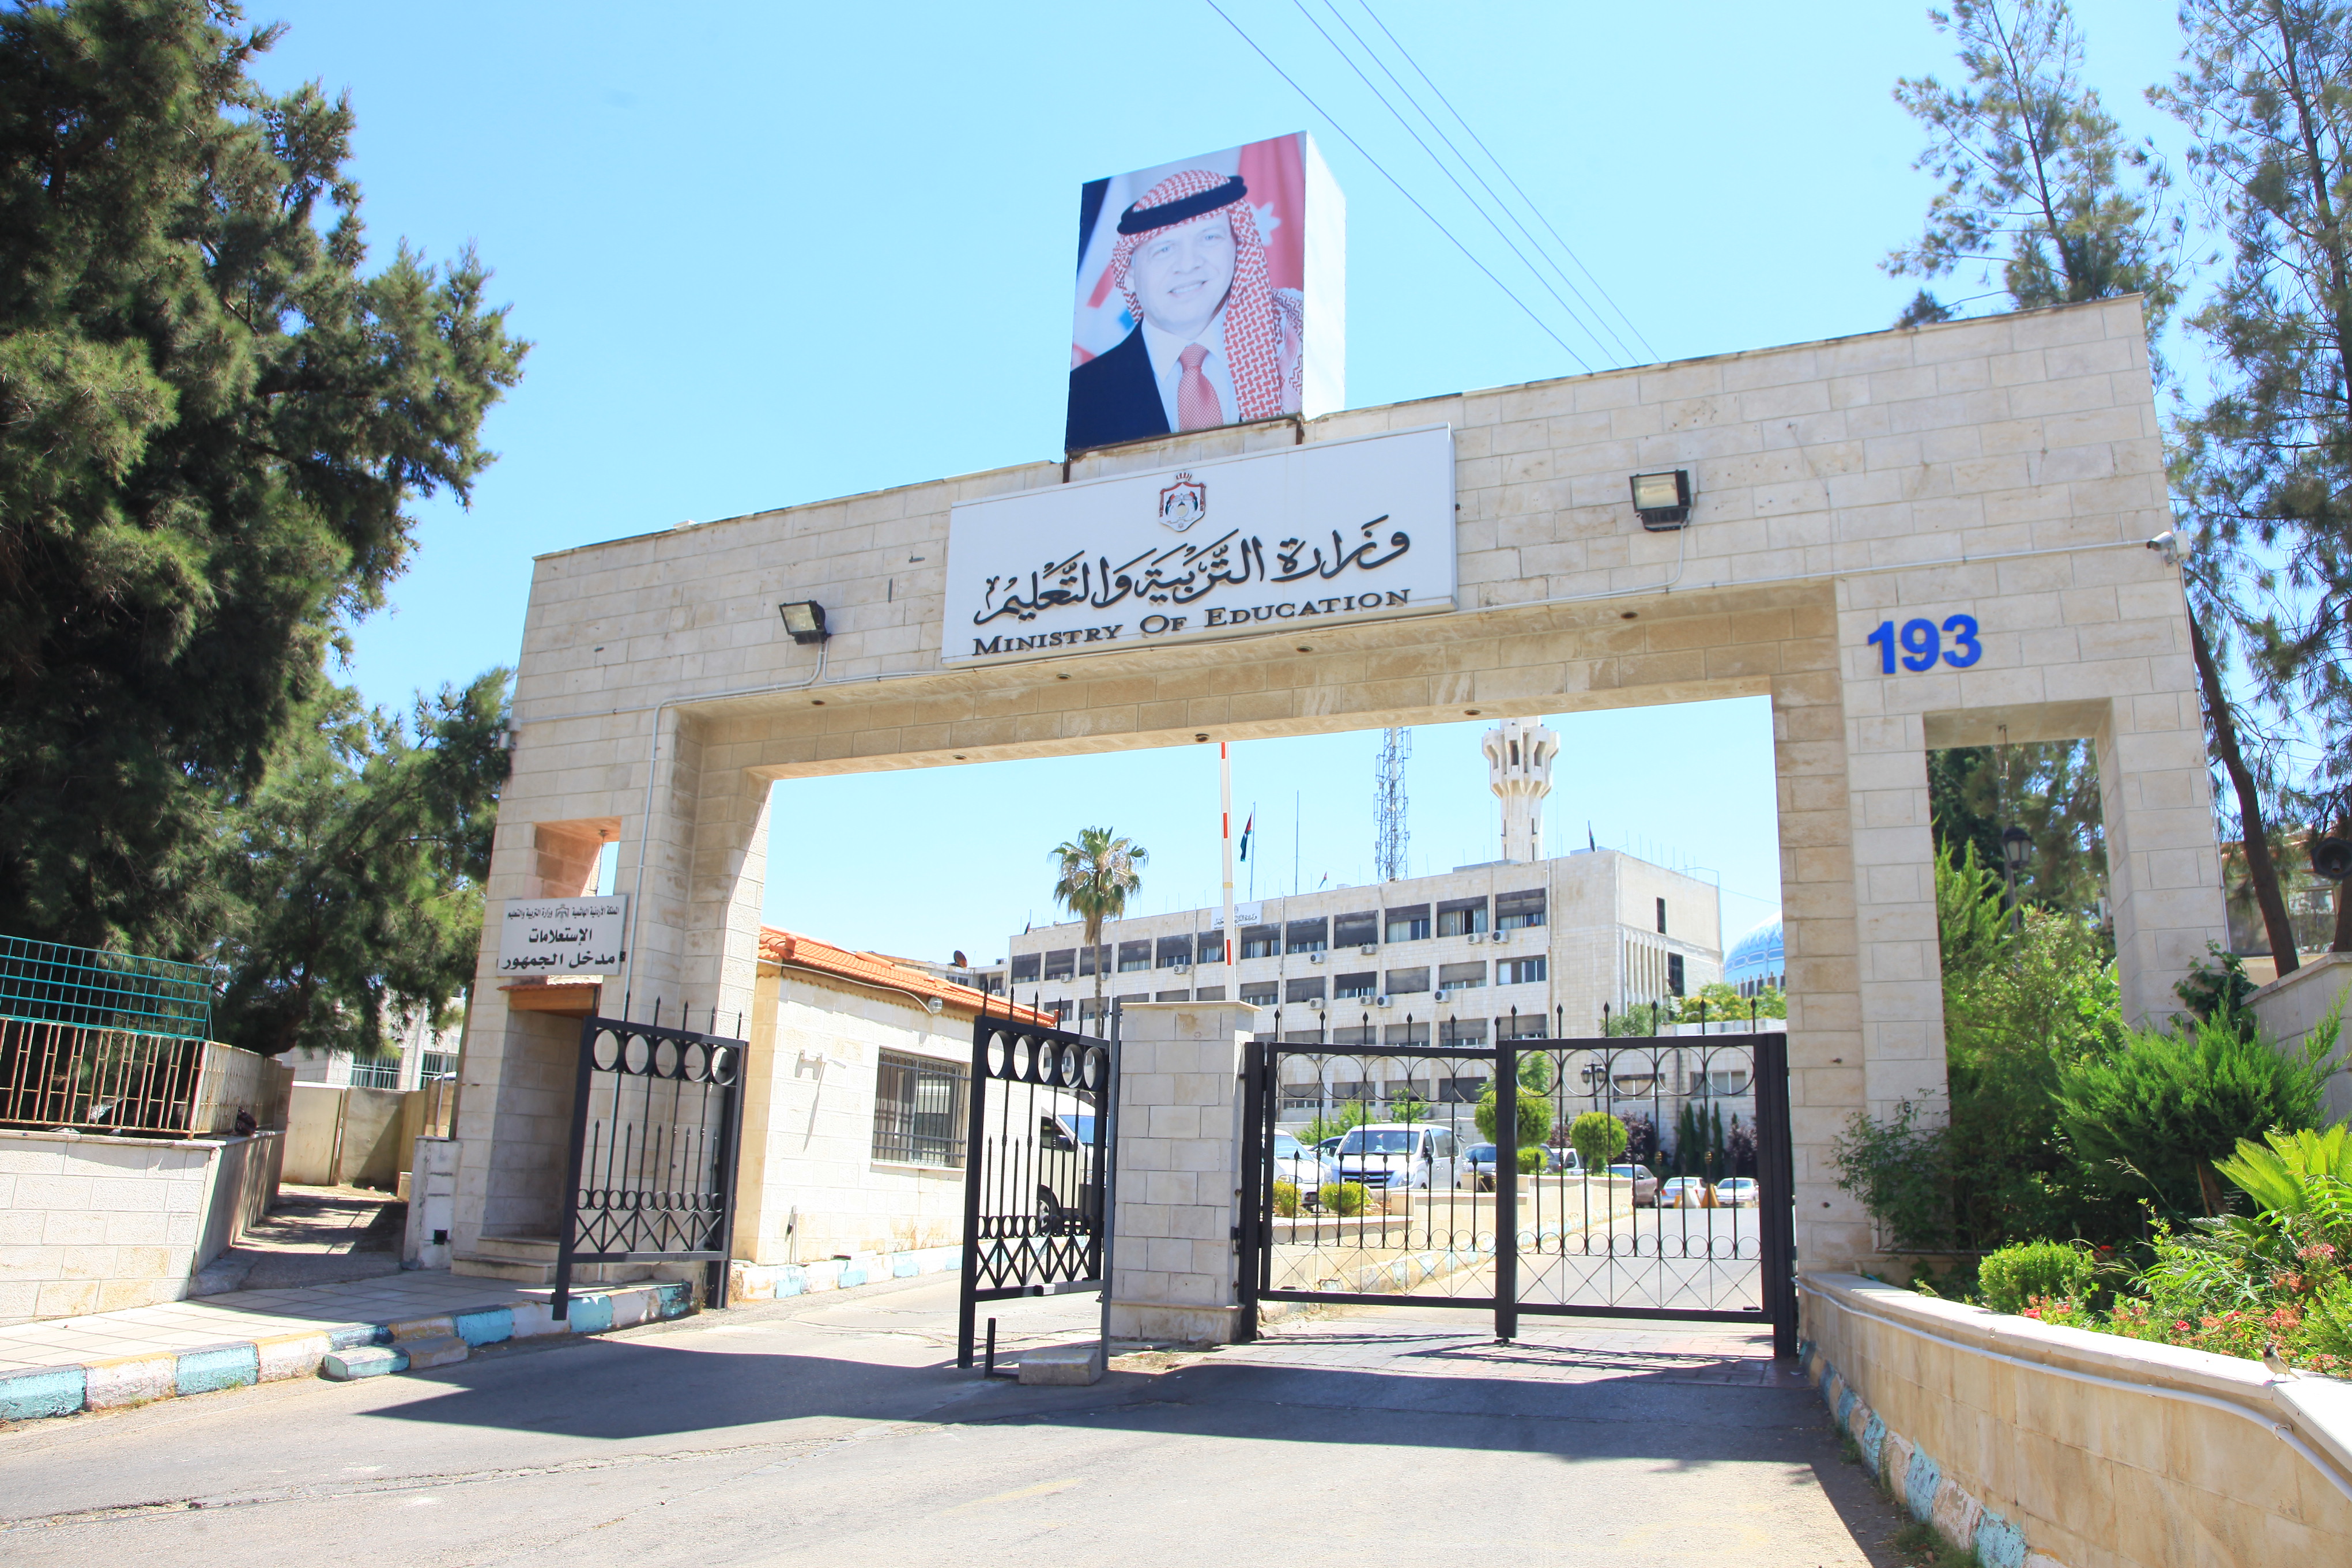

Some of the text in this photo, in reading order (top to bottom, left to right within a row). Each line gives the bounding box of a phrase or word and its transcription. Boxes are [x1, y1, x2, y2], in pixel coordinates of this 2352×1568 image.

[1270, 514, 1411, 582] وزارة
[972, 589, 1411, 655] MINISTRY OF EDUCATION
[1868, 614, 1982, 674] 193
[541, 907, 553, 918] وزارة
[529, 928, 593, 945] الإستعلامات
[501, 951, 616, 970] مدخل الجمهور
